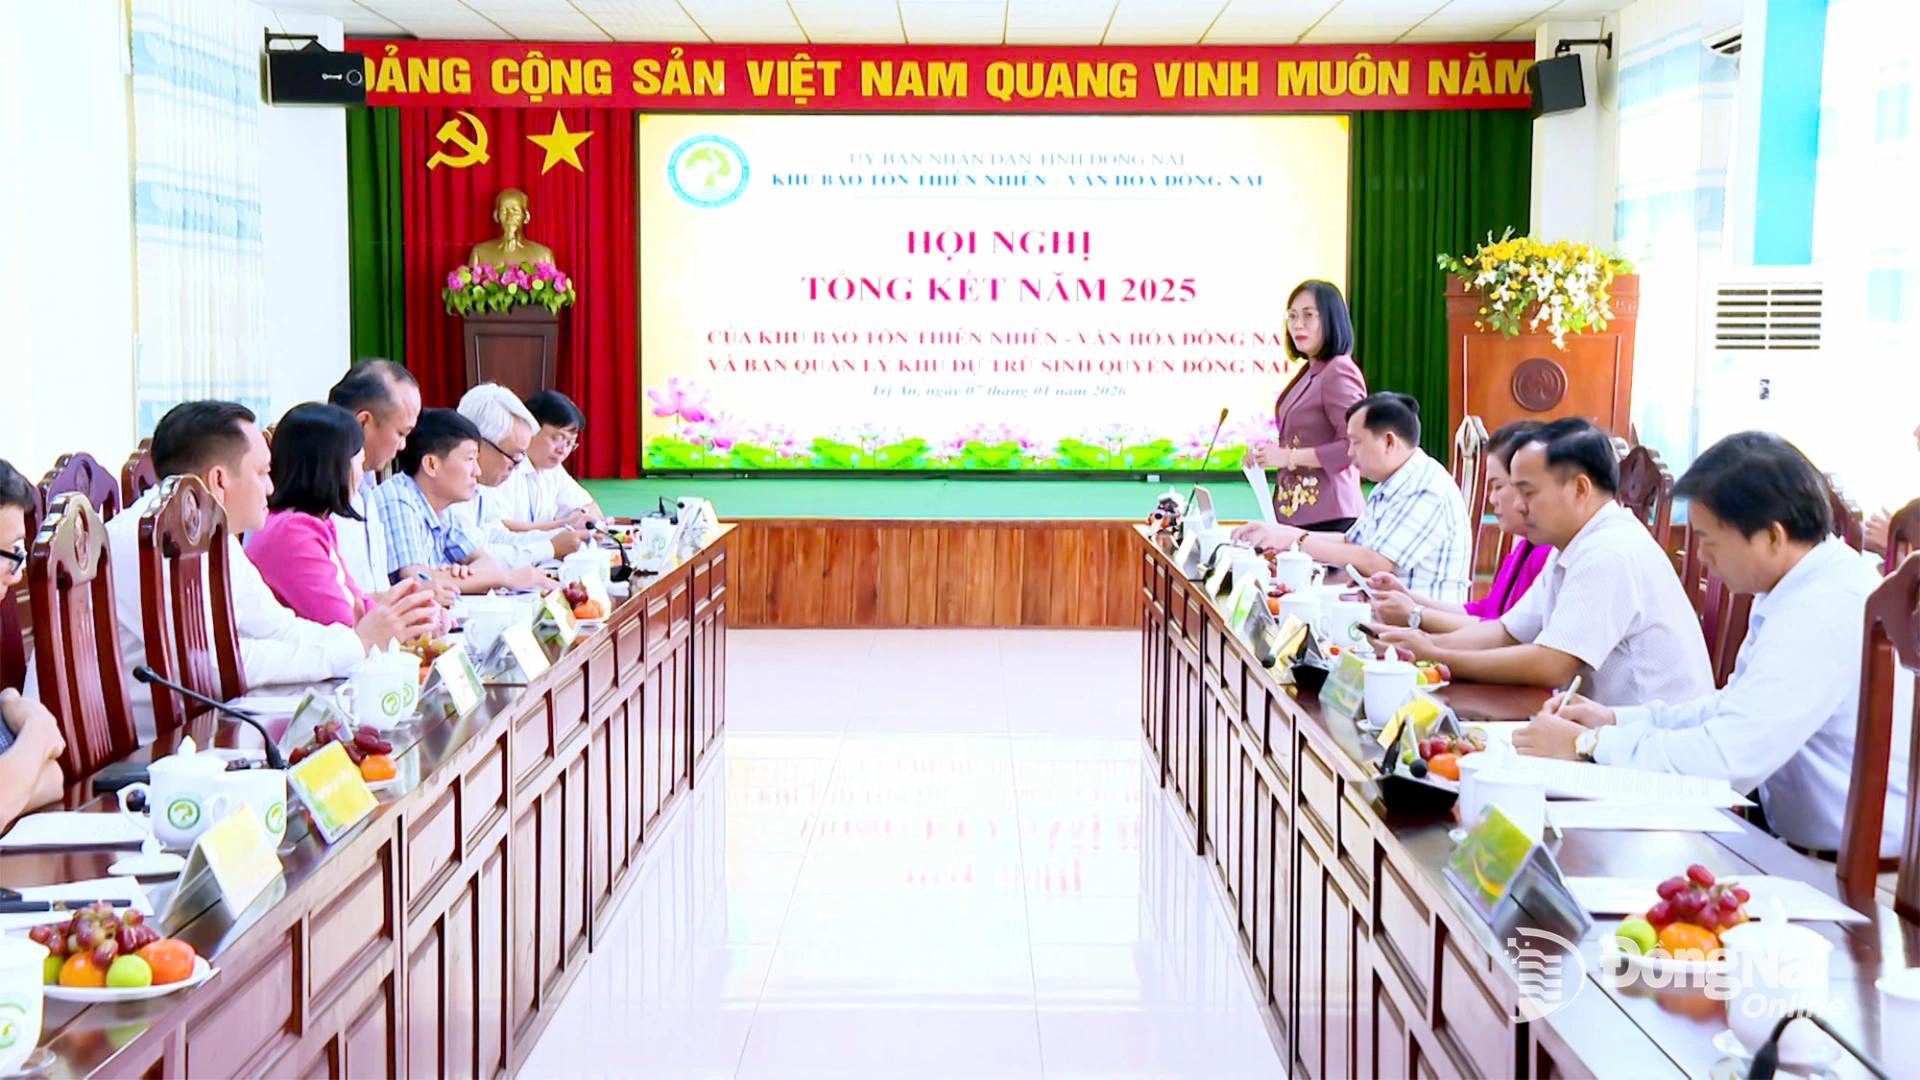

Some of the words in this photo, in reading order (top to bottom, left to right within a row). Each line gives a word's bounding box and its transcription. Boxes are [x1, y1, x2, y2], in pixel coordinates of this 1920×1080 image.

[490, 51, 612, 102] CỘNG
[632, 48, 725, 95] SẢN
[746, 54, 842, 104] VIỆT
[861, 61, 969, 97] NAM
[986, 61, 1137, 101] QUANG
[1154, 61, 1259, 97] VINH
[1277, 53, 1409, 97] MUÔN
[1428, 53, 1534, 96] NĂM
[883, 152, 923, 166] BAN
[1151, 153, 1184, 166] NAI
[771, 172, 815, 188] KHU
[1228, 173, 1263, 188] NAI
[906, 226, 977, 263] HỘI
[992, 229, 1091, 263] NGHỊ
[927, 269, 1008, 303] KẾT
[1018, 270, 1107, 303] NĂM
[1120, 276, 1198, 304] 2025
[758, 330, 806, 346] KHU
[1251, 331, 1283, 348] NA
[744, 357, 789, 374] BAN
[898, 358, 945, 374] KHU
[1040, 359, 1093, 375] SINH
[1251, 359, 1289, 375] NAI
[1091, 384, 1128, 398] 2026
